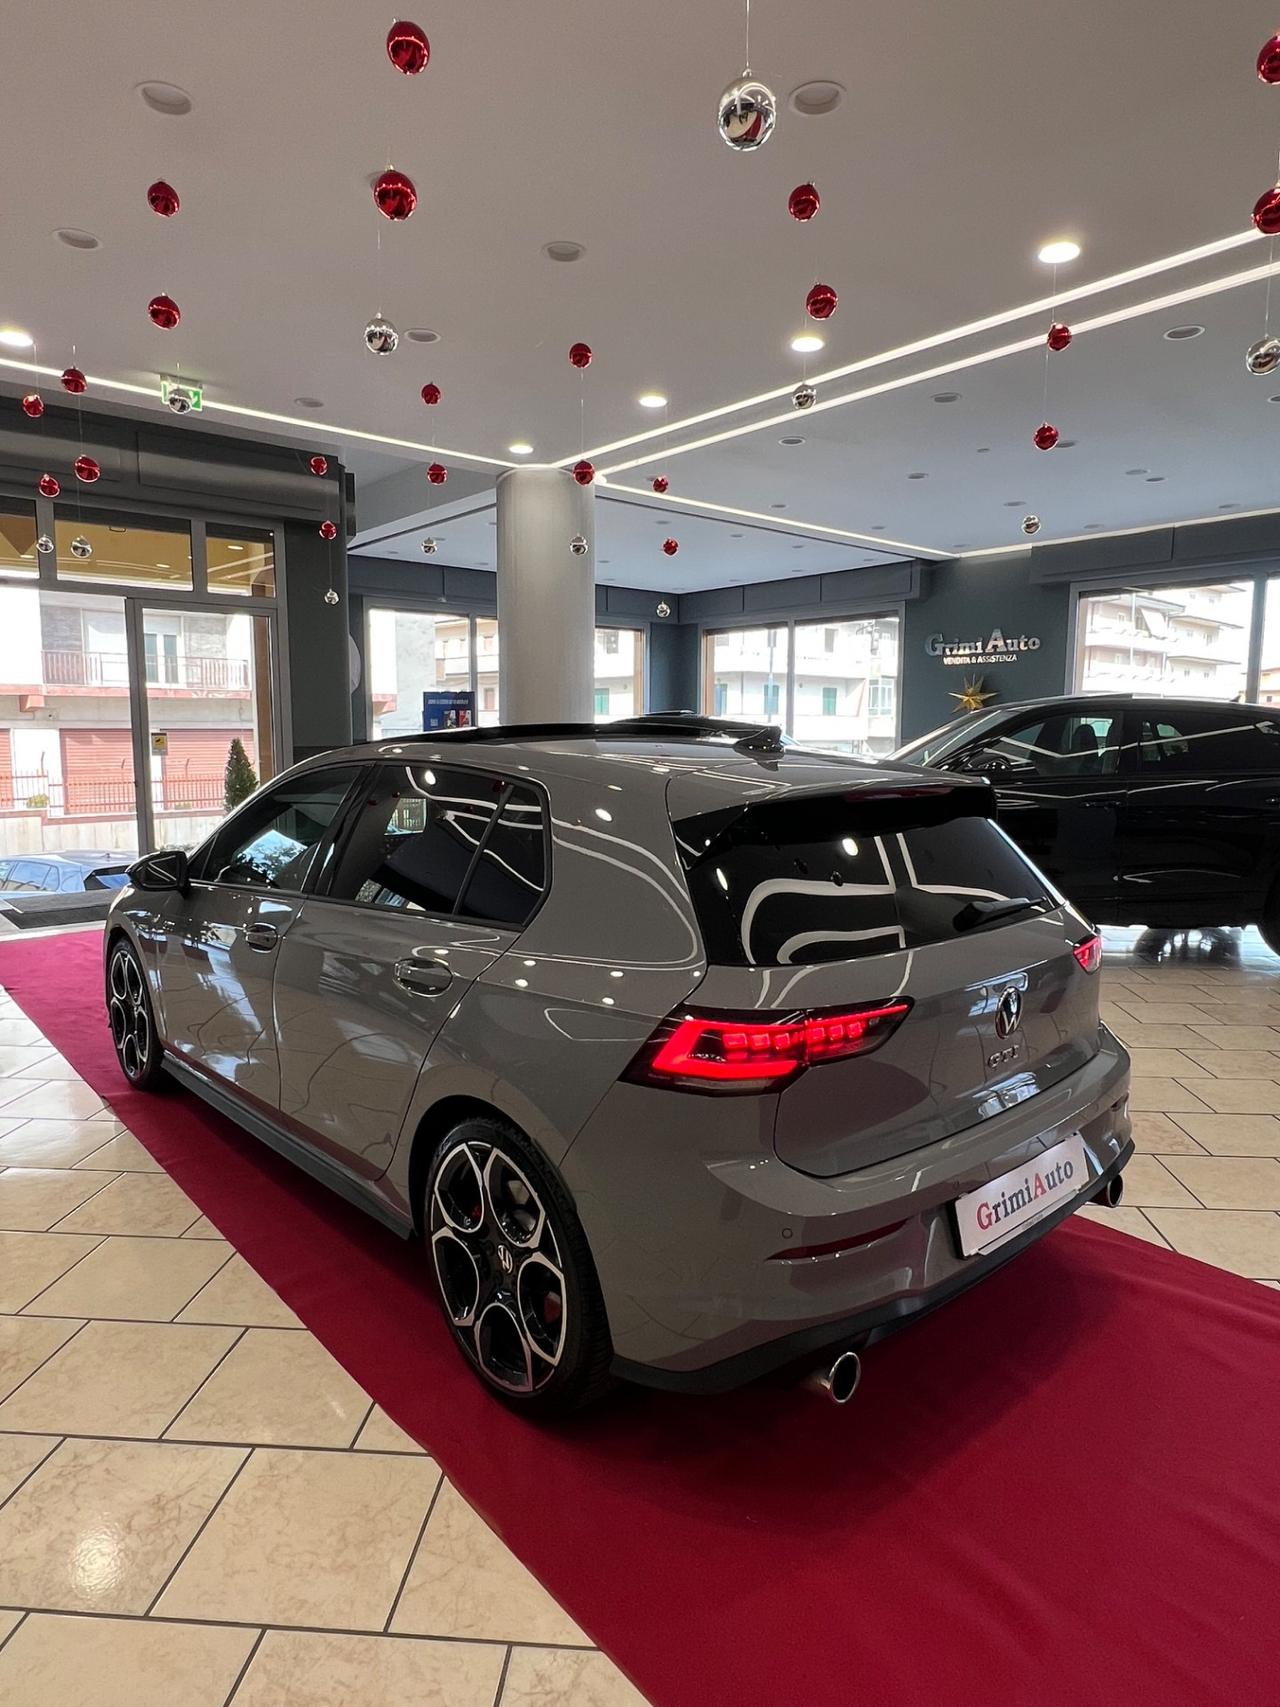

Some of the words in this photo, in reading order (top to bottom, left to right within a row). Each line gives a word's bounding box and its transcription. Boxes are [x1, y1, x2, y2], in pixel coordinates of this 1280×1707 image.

[943, 656, 970, 665] VENDITA
[977, 654, 1017, 664] ASSISTENZA
[988, 1045, 1019, 1068] GTI
[976, 1160, 1074, 1231] GrimiAuto
